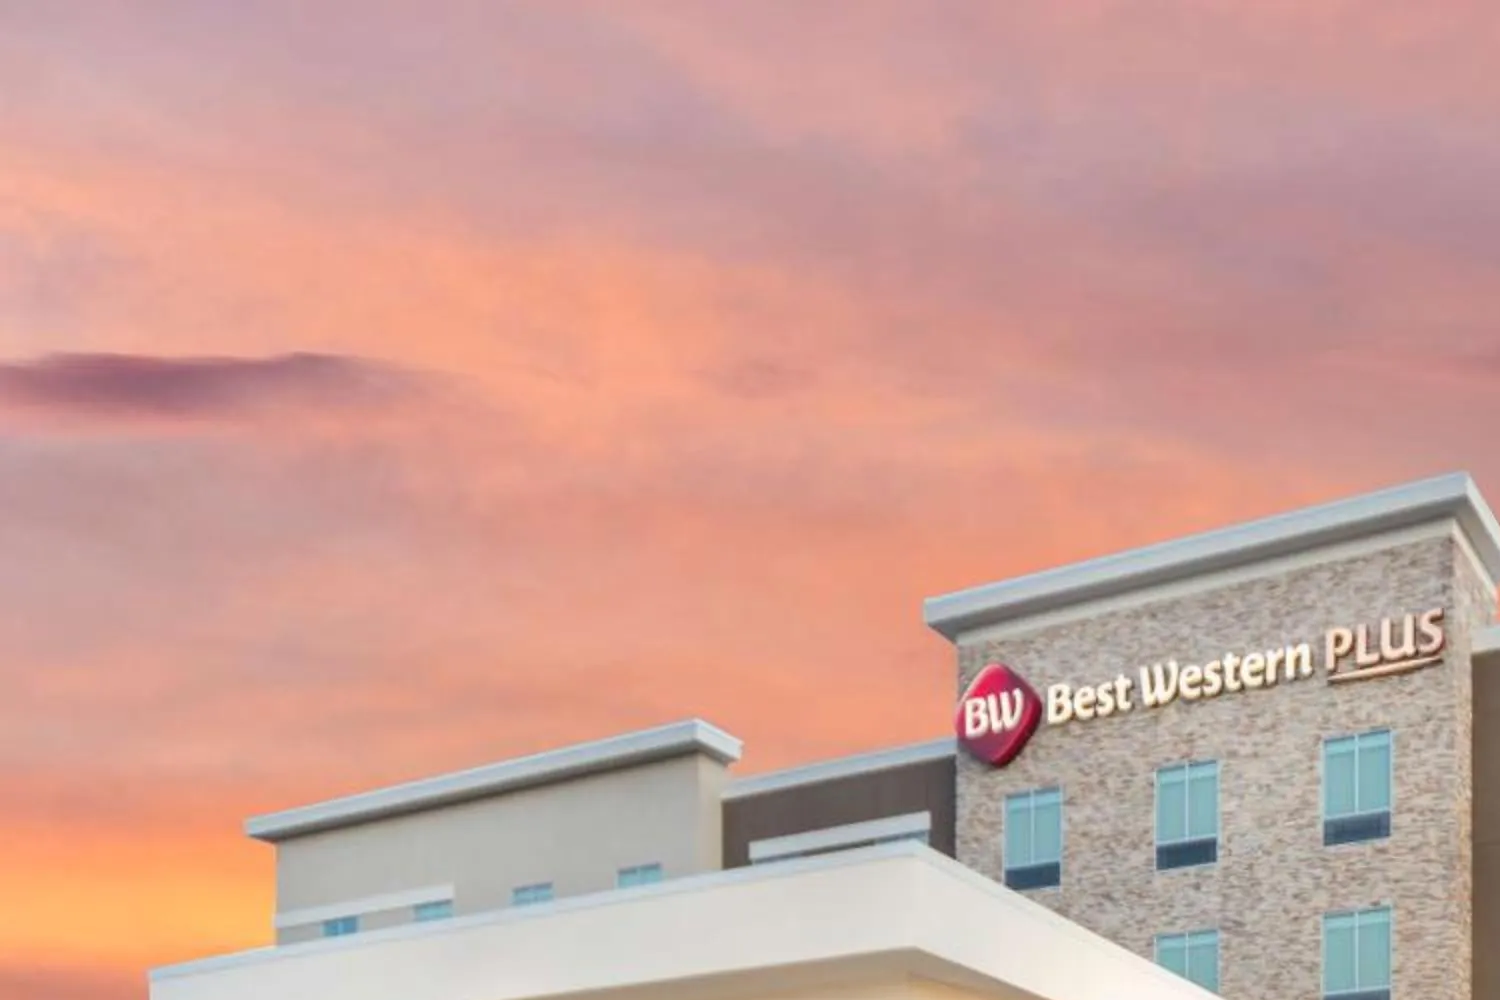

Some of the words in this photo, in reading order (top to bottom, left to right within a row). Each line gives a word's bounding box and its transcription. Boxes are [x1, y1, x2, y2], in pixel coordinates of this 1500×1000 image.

[1047, 674, 1133, 724] Best
[1139, 643, 1313, 706] Western
[1325, 607, 1444, 671] PLUS
[965, 687, 1024, 738] BW
